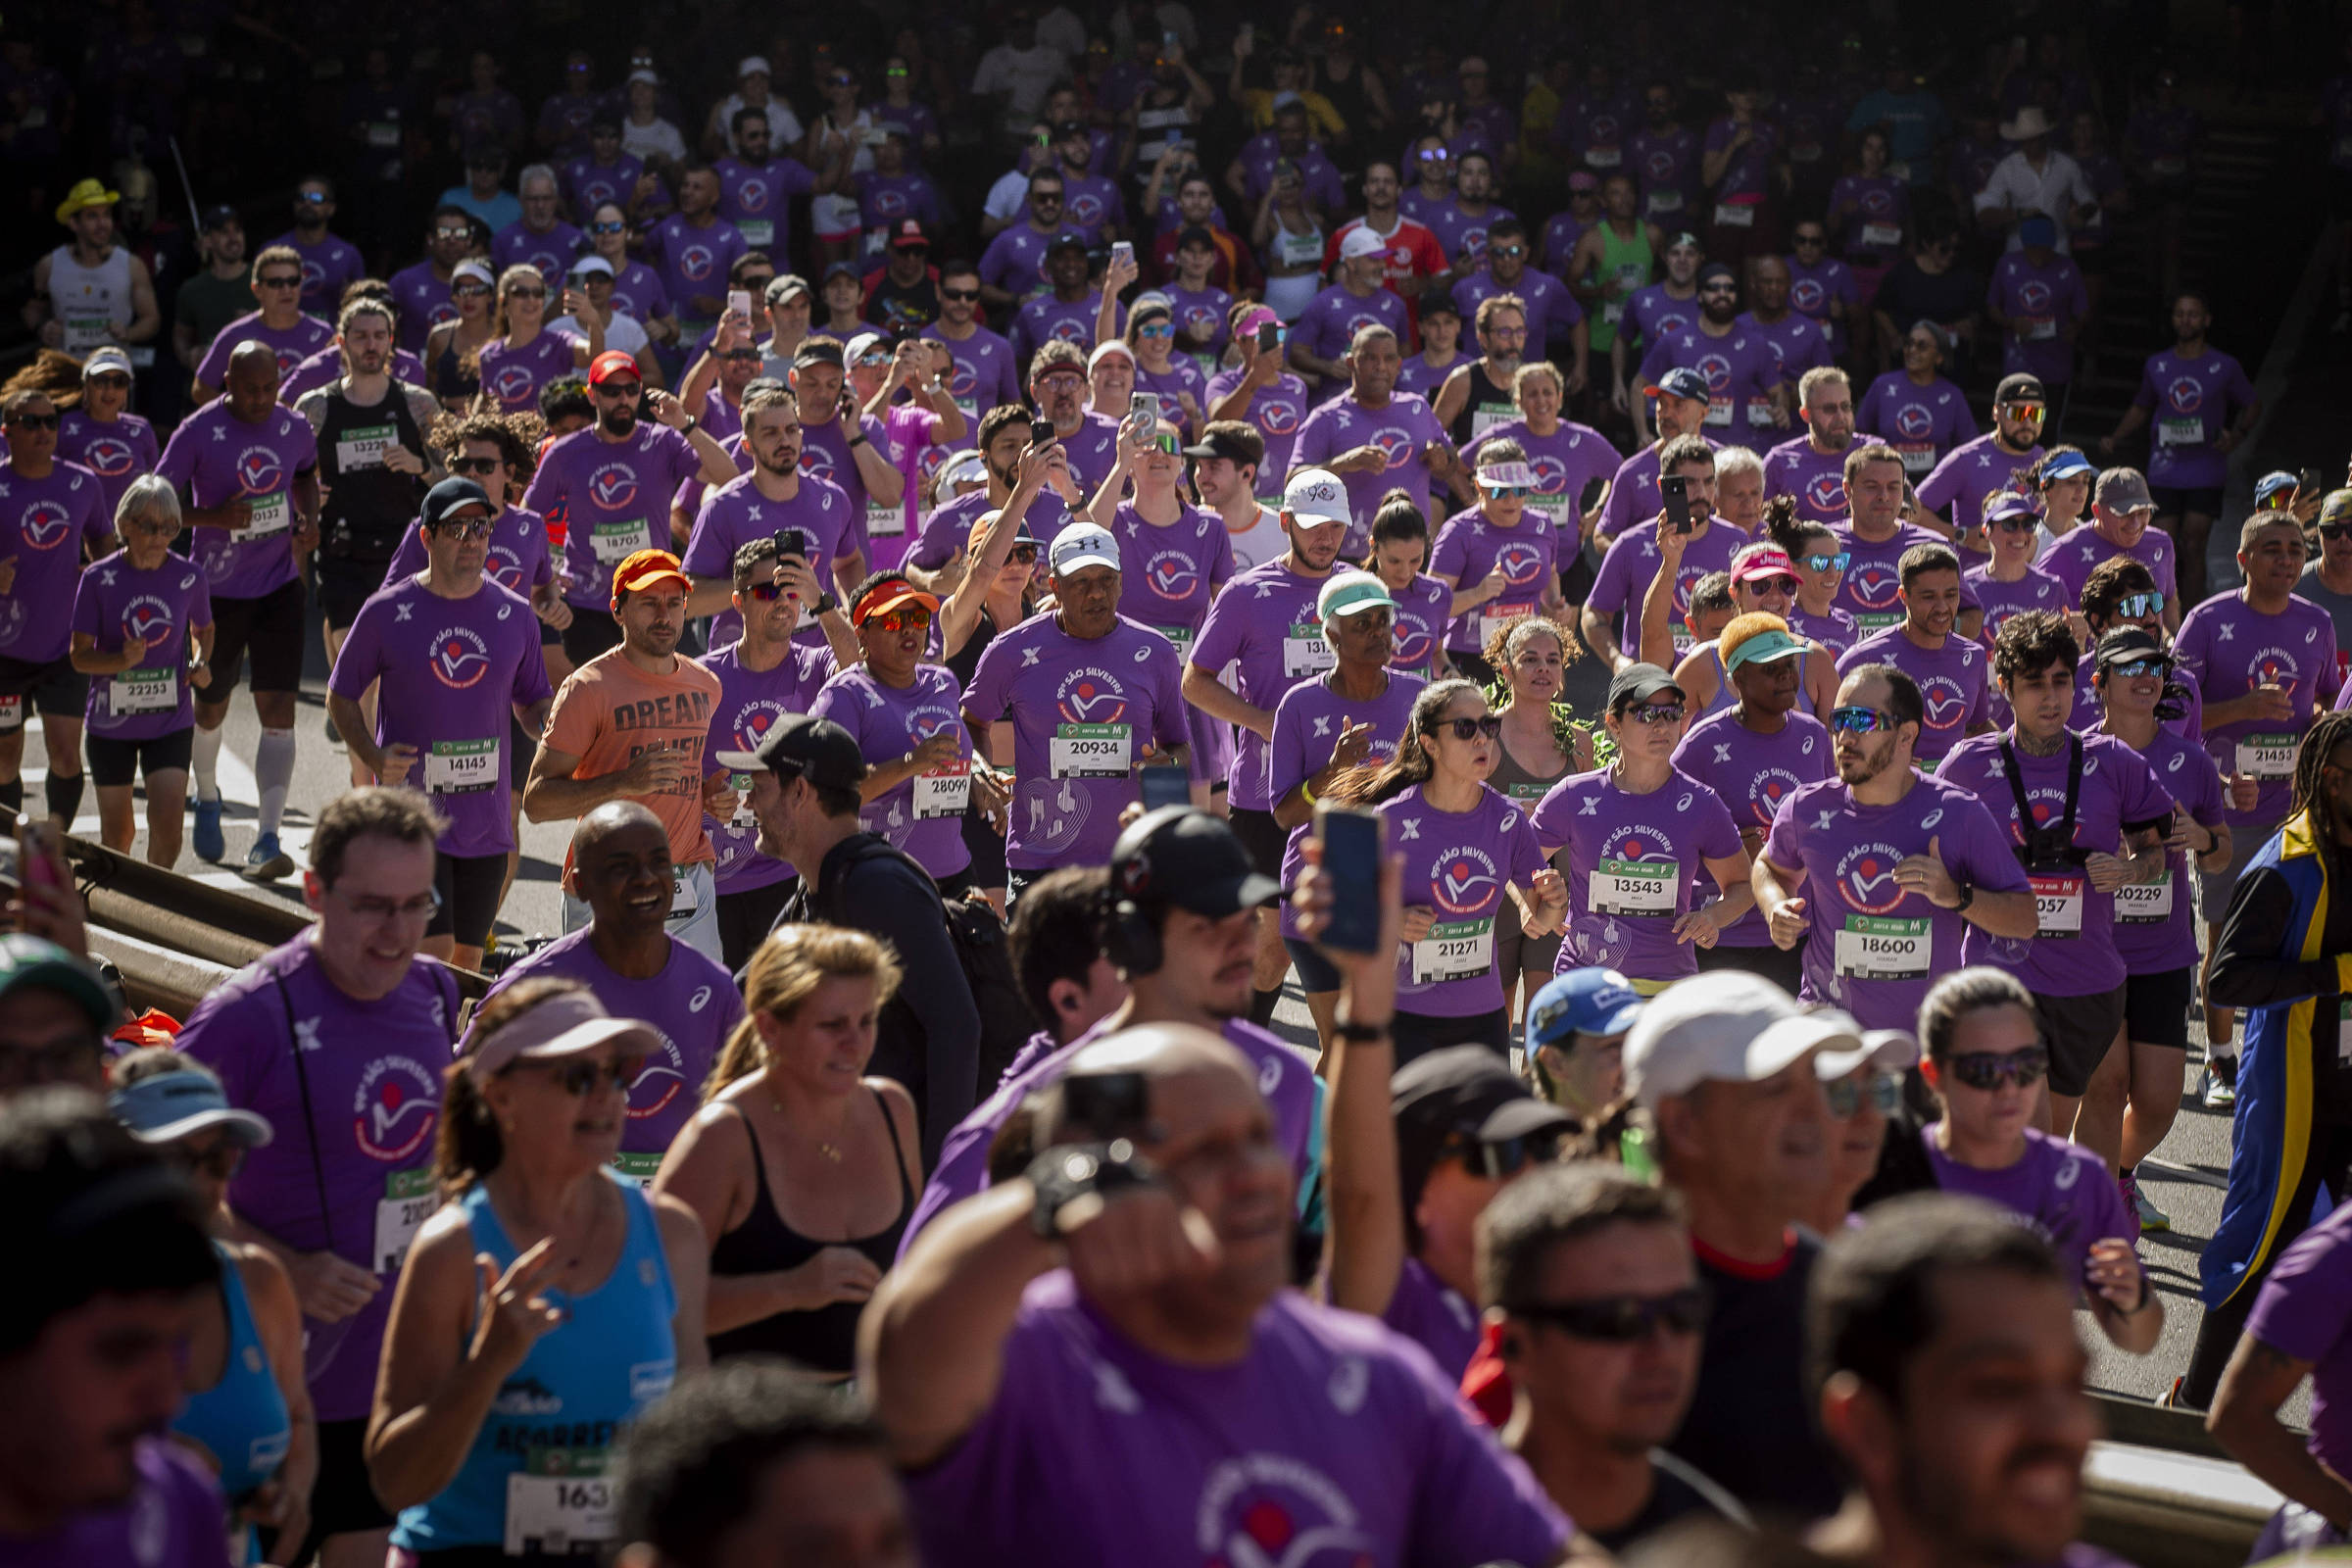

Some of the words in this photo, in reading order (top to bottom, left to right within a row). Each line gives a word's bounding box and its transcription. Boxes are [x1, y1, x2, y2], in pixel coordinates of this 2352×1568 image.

[606, 534, 640, 549] 18705
[1759, 552, 1788, 568] Jeep
[436, 628, 453, 644] SÃO
[455, 626, 487, 655] SILVESTRE
[1064, 669, 1085, 686] SÃO
[1085, 667, 1124, 695] SILVESTRE
[1936, 676, 1965, 699] SILVESTRE
[128, 683, 168, 697] 22253
[613, 691, 710, 732] DREAM
[742, 701, 760, 716] SÃO
[1112, 725, 1123, 735] M
[1069, 741, 1119, 755] 20934
[448, 756, 487, 772] 14145
[1755, 770, 1770, 785] SÃO
[932, 778, 968, 794] 28099
[1611, 826, 1633, 843] SÃO
[1634, 824, 1673, 854] SILVESTRE
[1846, 845, 1870, 861] SÃO
[1440, 849, 1460, 865] SÃO
[1461, 846, 1496, 877] SILVESTRE
[1613, 878, 1664, 895] 13543
[2062, 880, 2073, 893] M
[2114, 887, 2162, 902] 20229
[1909, 919, 1921, 932] M
[1438, 938, 1478, 956] 21271
[1860, 936, 1916, 954] 18600
